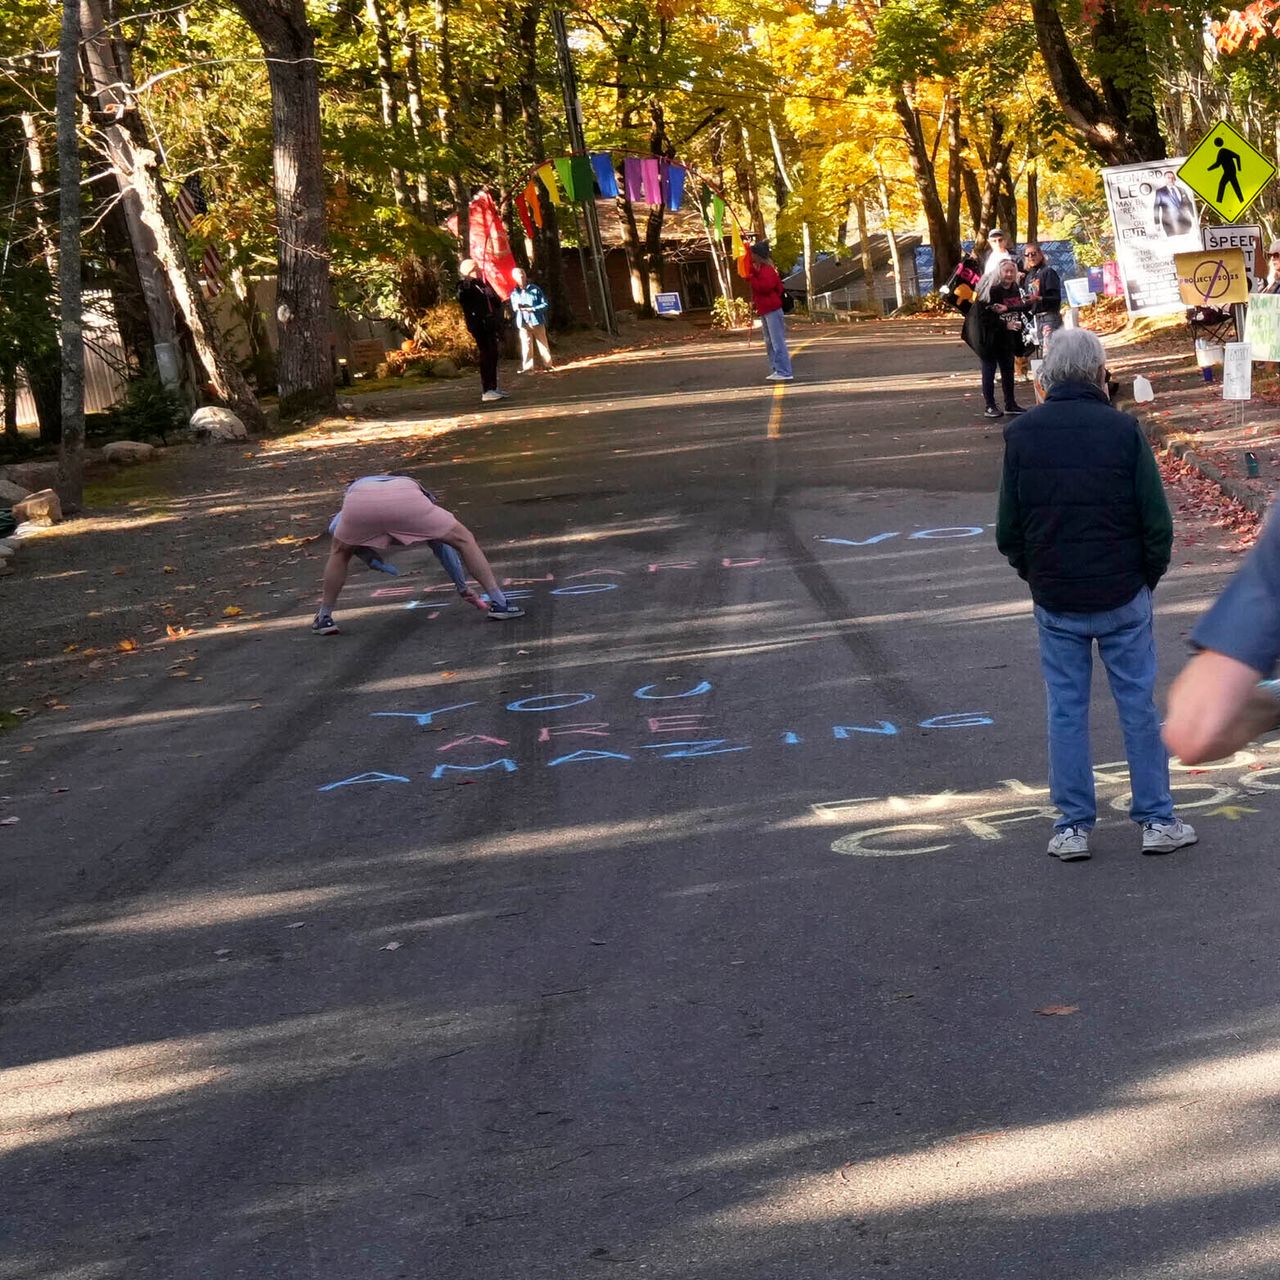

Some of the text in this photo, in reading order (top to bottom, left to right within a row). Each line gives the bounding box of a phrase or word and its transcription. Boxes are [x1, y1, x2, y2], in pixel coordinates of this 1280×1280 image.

[1116, 182, 1153, 199] LEO
[369, 680, 712, 725] YOU
[318, 711, 994, 792] AMAZING
[436, 713, 710, 752] ARE
